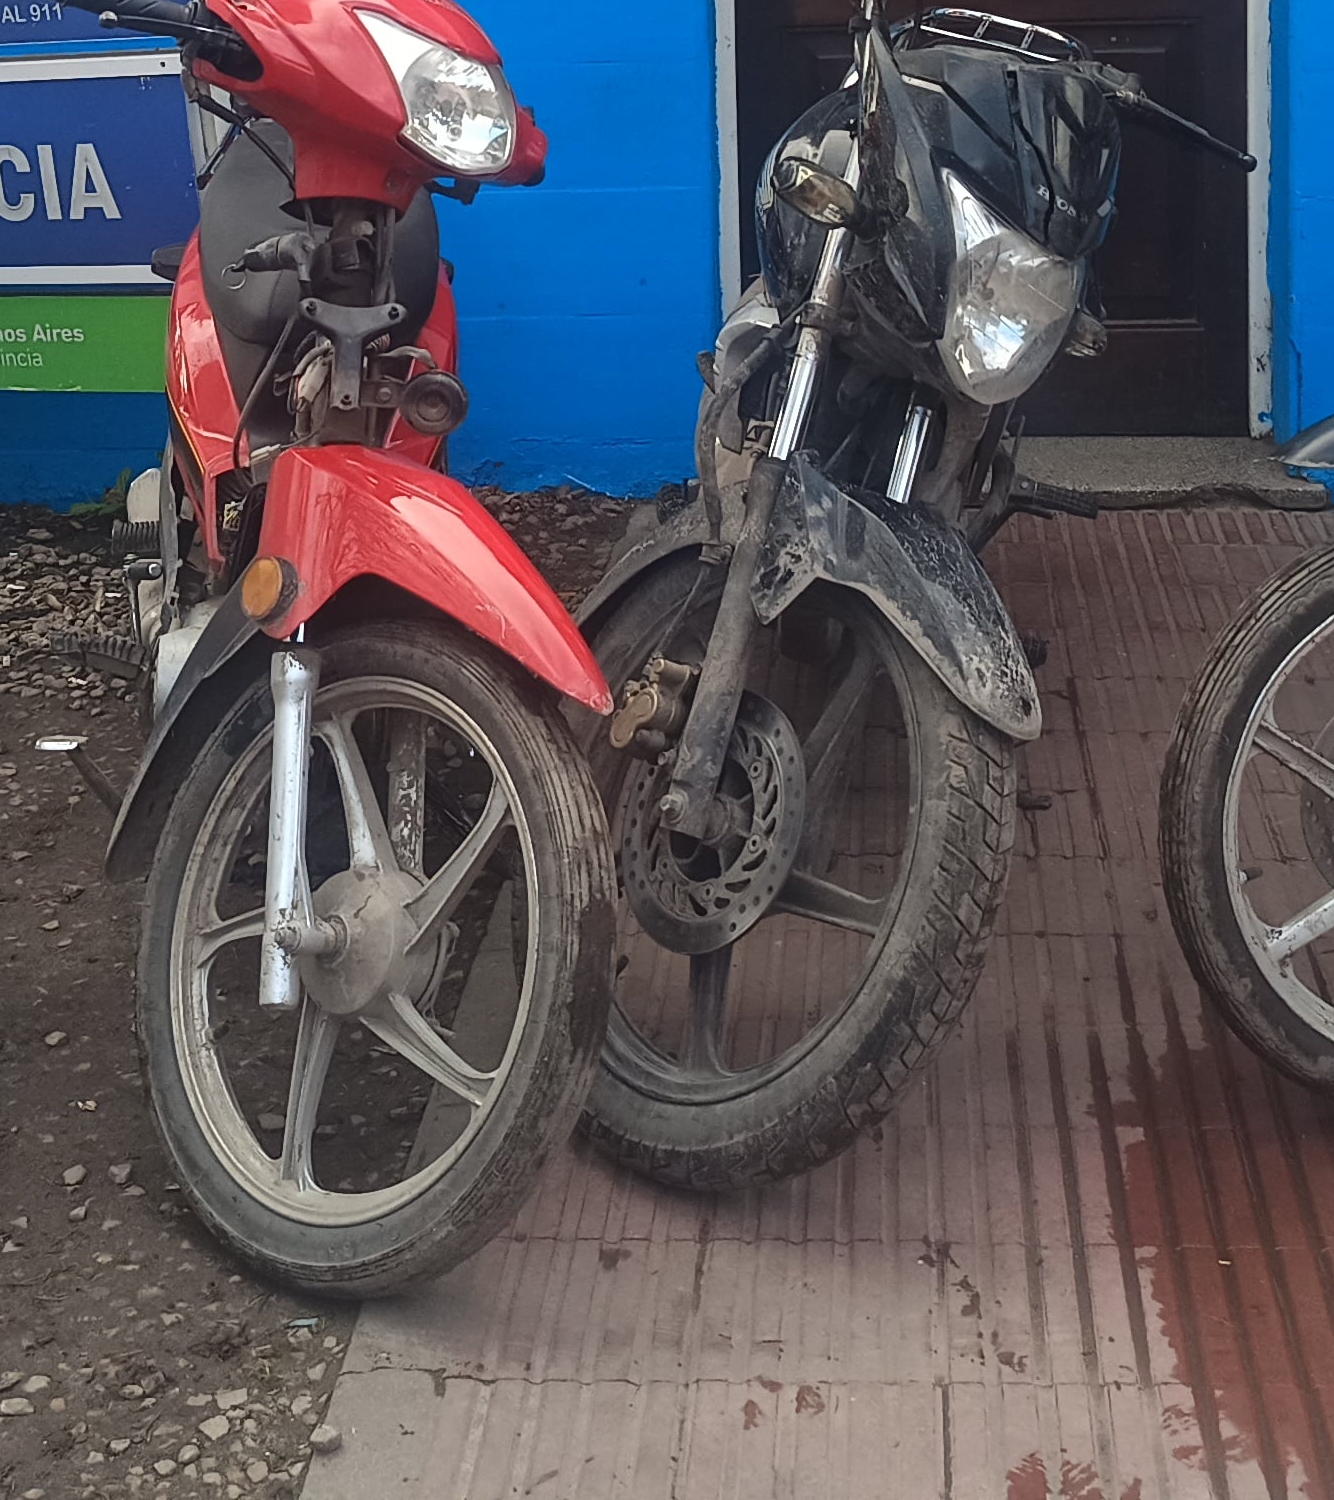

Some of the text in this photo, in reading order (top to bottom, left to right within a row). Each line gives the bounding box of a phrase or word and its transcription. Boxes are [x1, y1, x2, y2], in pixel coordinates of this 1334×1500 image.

[2, 5, 27, 24] AL
[30, 3, 63, 21] 911
[32, 323, 85, 343] Aires
